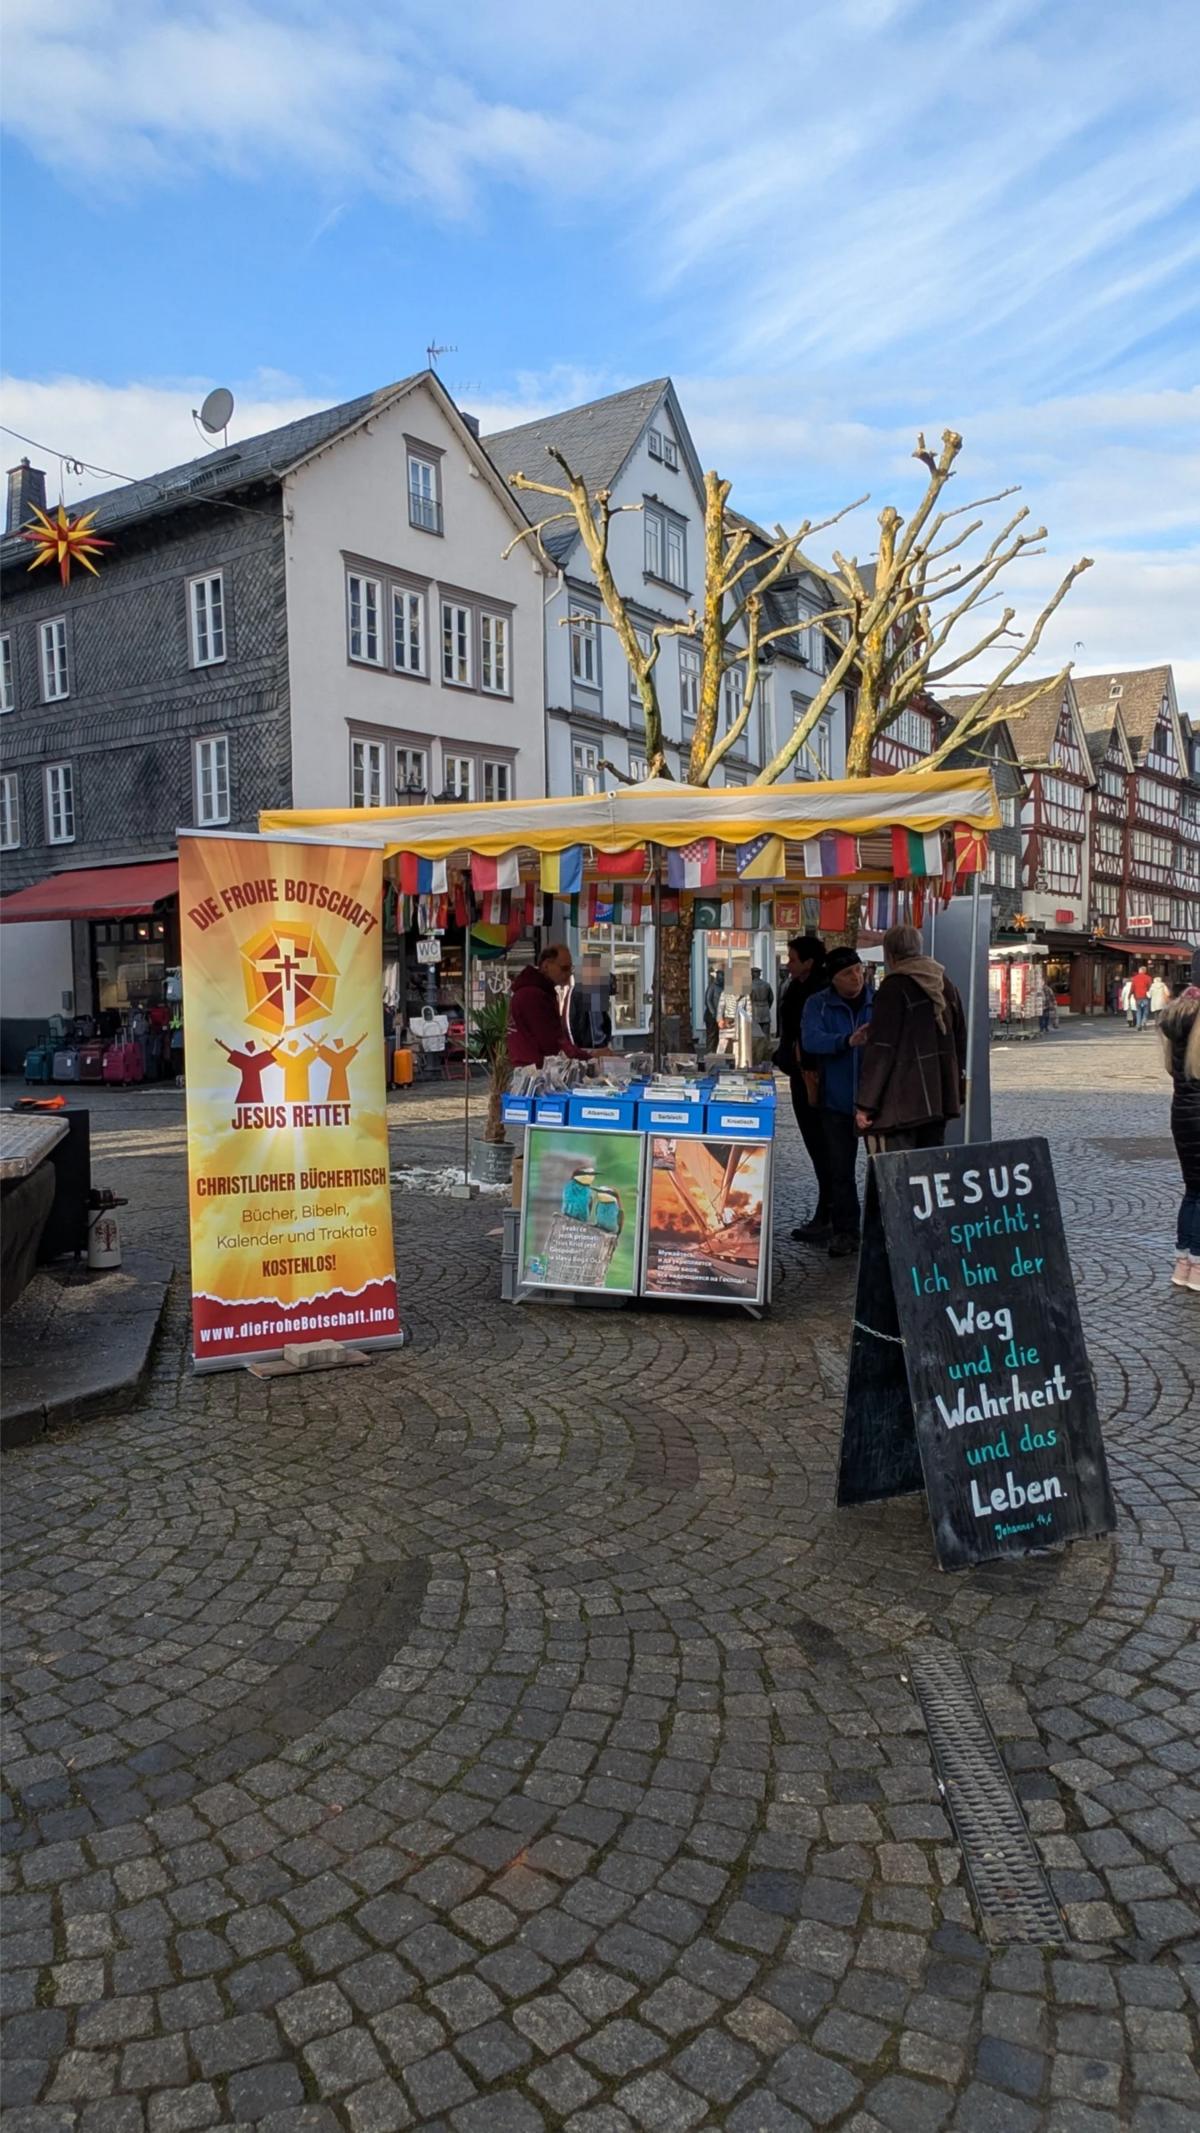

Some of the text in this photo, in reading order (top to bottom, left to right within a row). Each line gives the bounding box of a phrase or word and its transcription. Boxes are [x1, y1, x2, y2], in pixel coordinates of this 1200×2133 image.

[187, 878, 379, 936] DIE FROHE BOTSCHAFT
[419, 943, 438, 956] WC
[232, 1103, 351, 1129] JESUS RETTET
[196, 1167, 386, 1196] CHRISTLICHER BÜCHERTISCH
[909, 1163, 1034, 1220] JESUS
[242, 1204, 350, 1223] Bücher, Bibeln,
[217, 1224, 377, 1249] Kalender und Traktate
[262, 1254, 336, 1277] KOSTENLOS!
[911, 1247, 1045, 1297] Ich bin der
[200, 1307, 395, 1343] www.dieFroheBotschaft.info
[946, 1301, 1014, 1341] Weg
[948, 1340, 1041, 1380] und die
[935, 1364, 1073, 1430] Wahrheit
[965, 1424, 1058, 1467] und das
[970, 1471, 1069, 1518] Leben.
